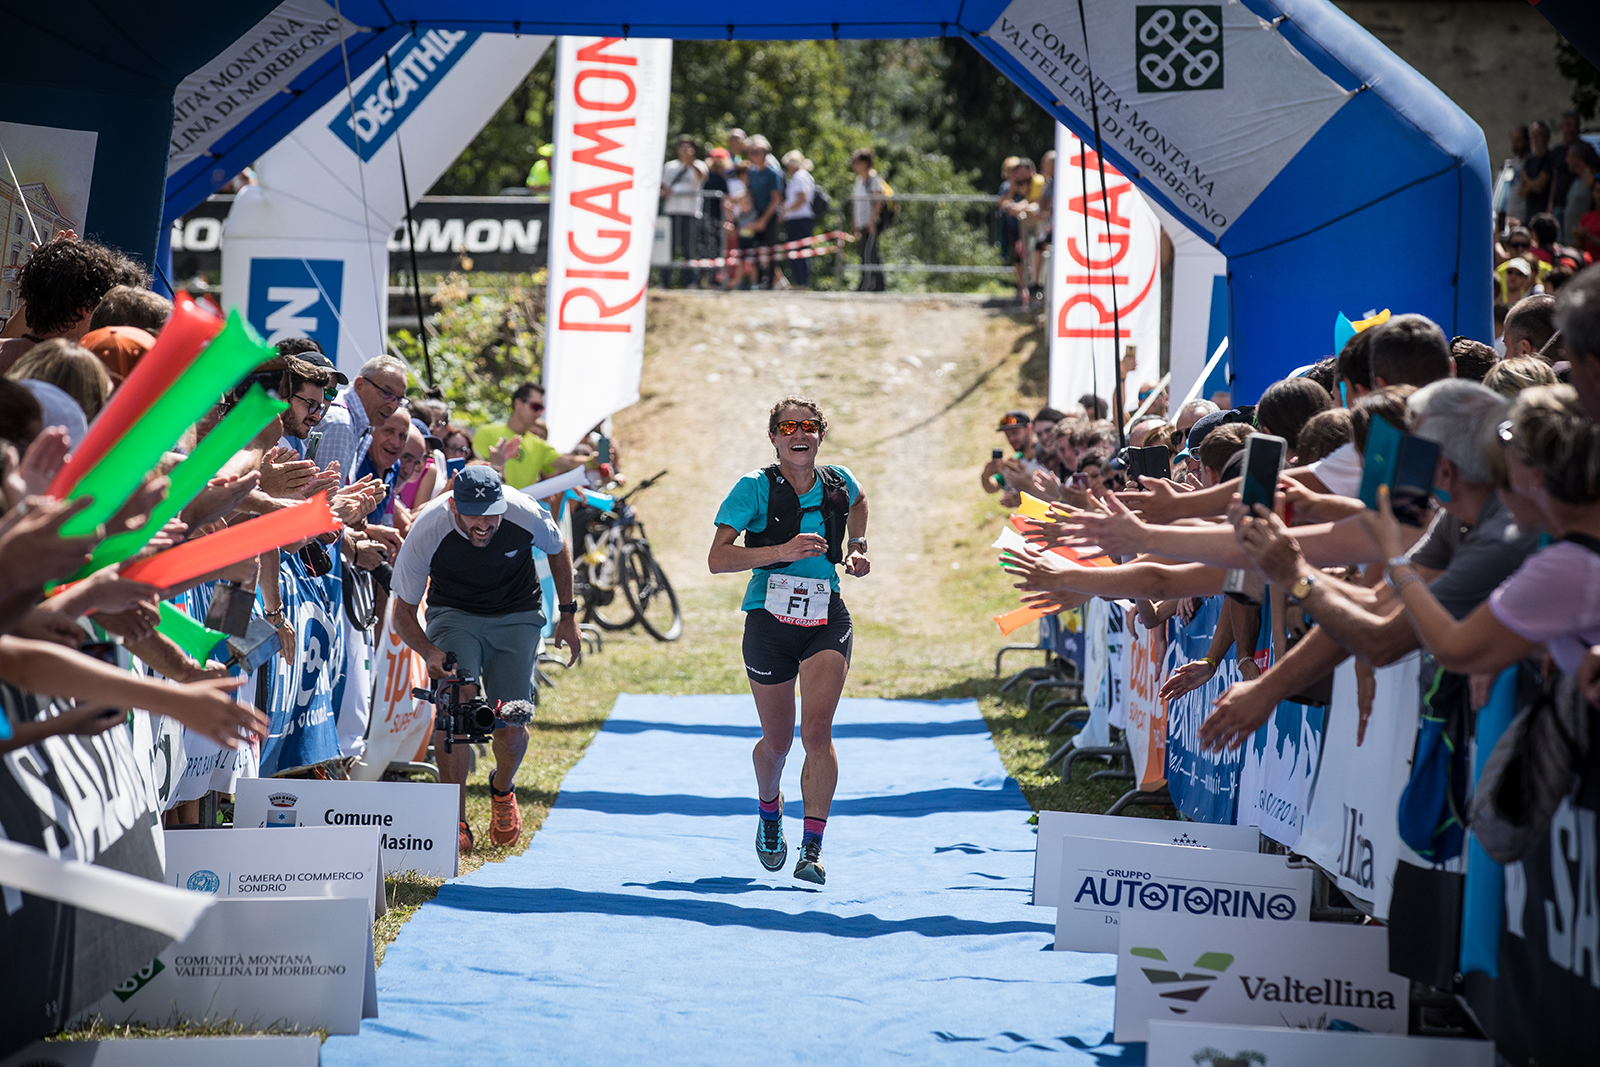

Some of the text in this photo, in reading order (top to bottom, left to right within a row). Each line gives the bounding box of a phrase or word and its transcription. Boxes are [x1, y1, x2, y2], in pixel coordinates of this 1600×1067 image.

[208, 18, 304, 93] MONTANA
[214, 95, 241, 117] DI
[238, 17, 343, 100] MORBEGNO
[1031, 22, 1216, 198] COMUNITA' MONTANA
[1000, 17, 1227, 228] VALTELLINA DI MORBEGNO
[787, 596, 810, 617] F1
[324, 808, 393, 826] Comune
[238, 871, 364, 883] CAMERA DI COMMERCIO
[1106, 868, 1152, 880] GRUPPO
[238, 883, 287, 893] SONDRIO
[1074, 876, 1297, 921] AUTOTORINO
[1104, 914, 1119, 925] Da
[174, 952, 313, 966] COMUNITÀ MONTANA
[175, 964, 346, 977] VALTELLINA DI MORBEGNO
[1239, 975, 1397, 1010] Valtellina
